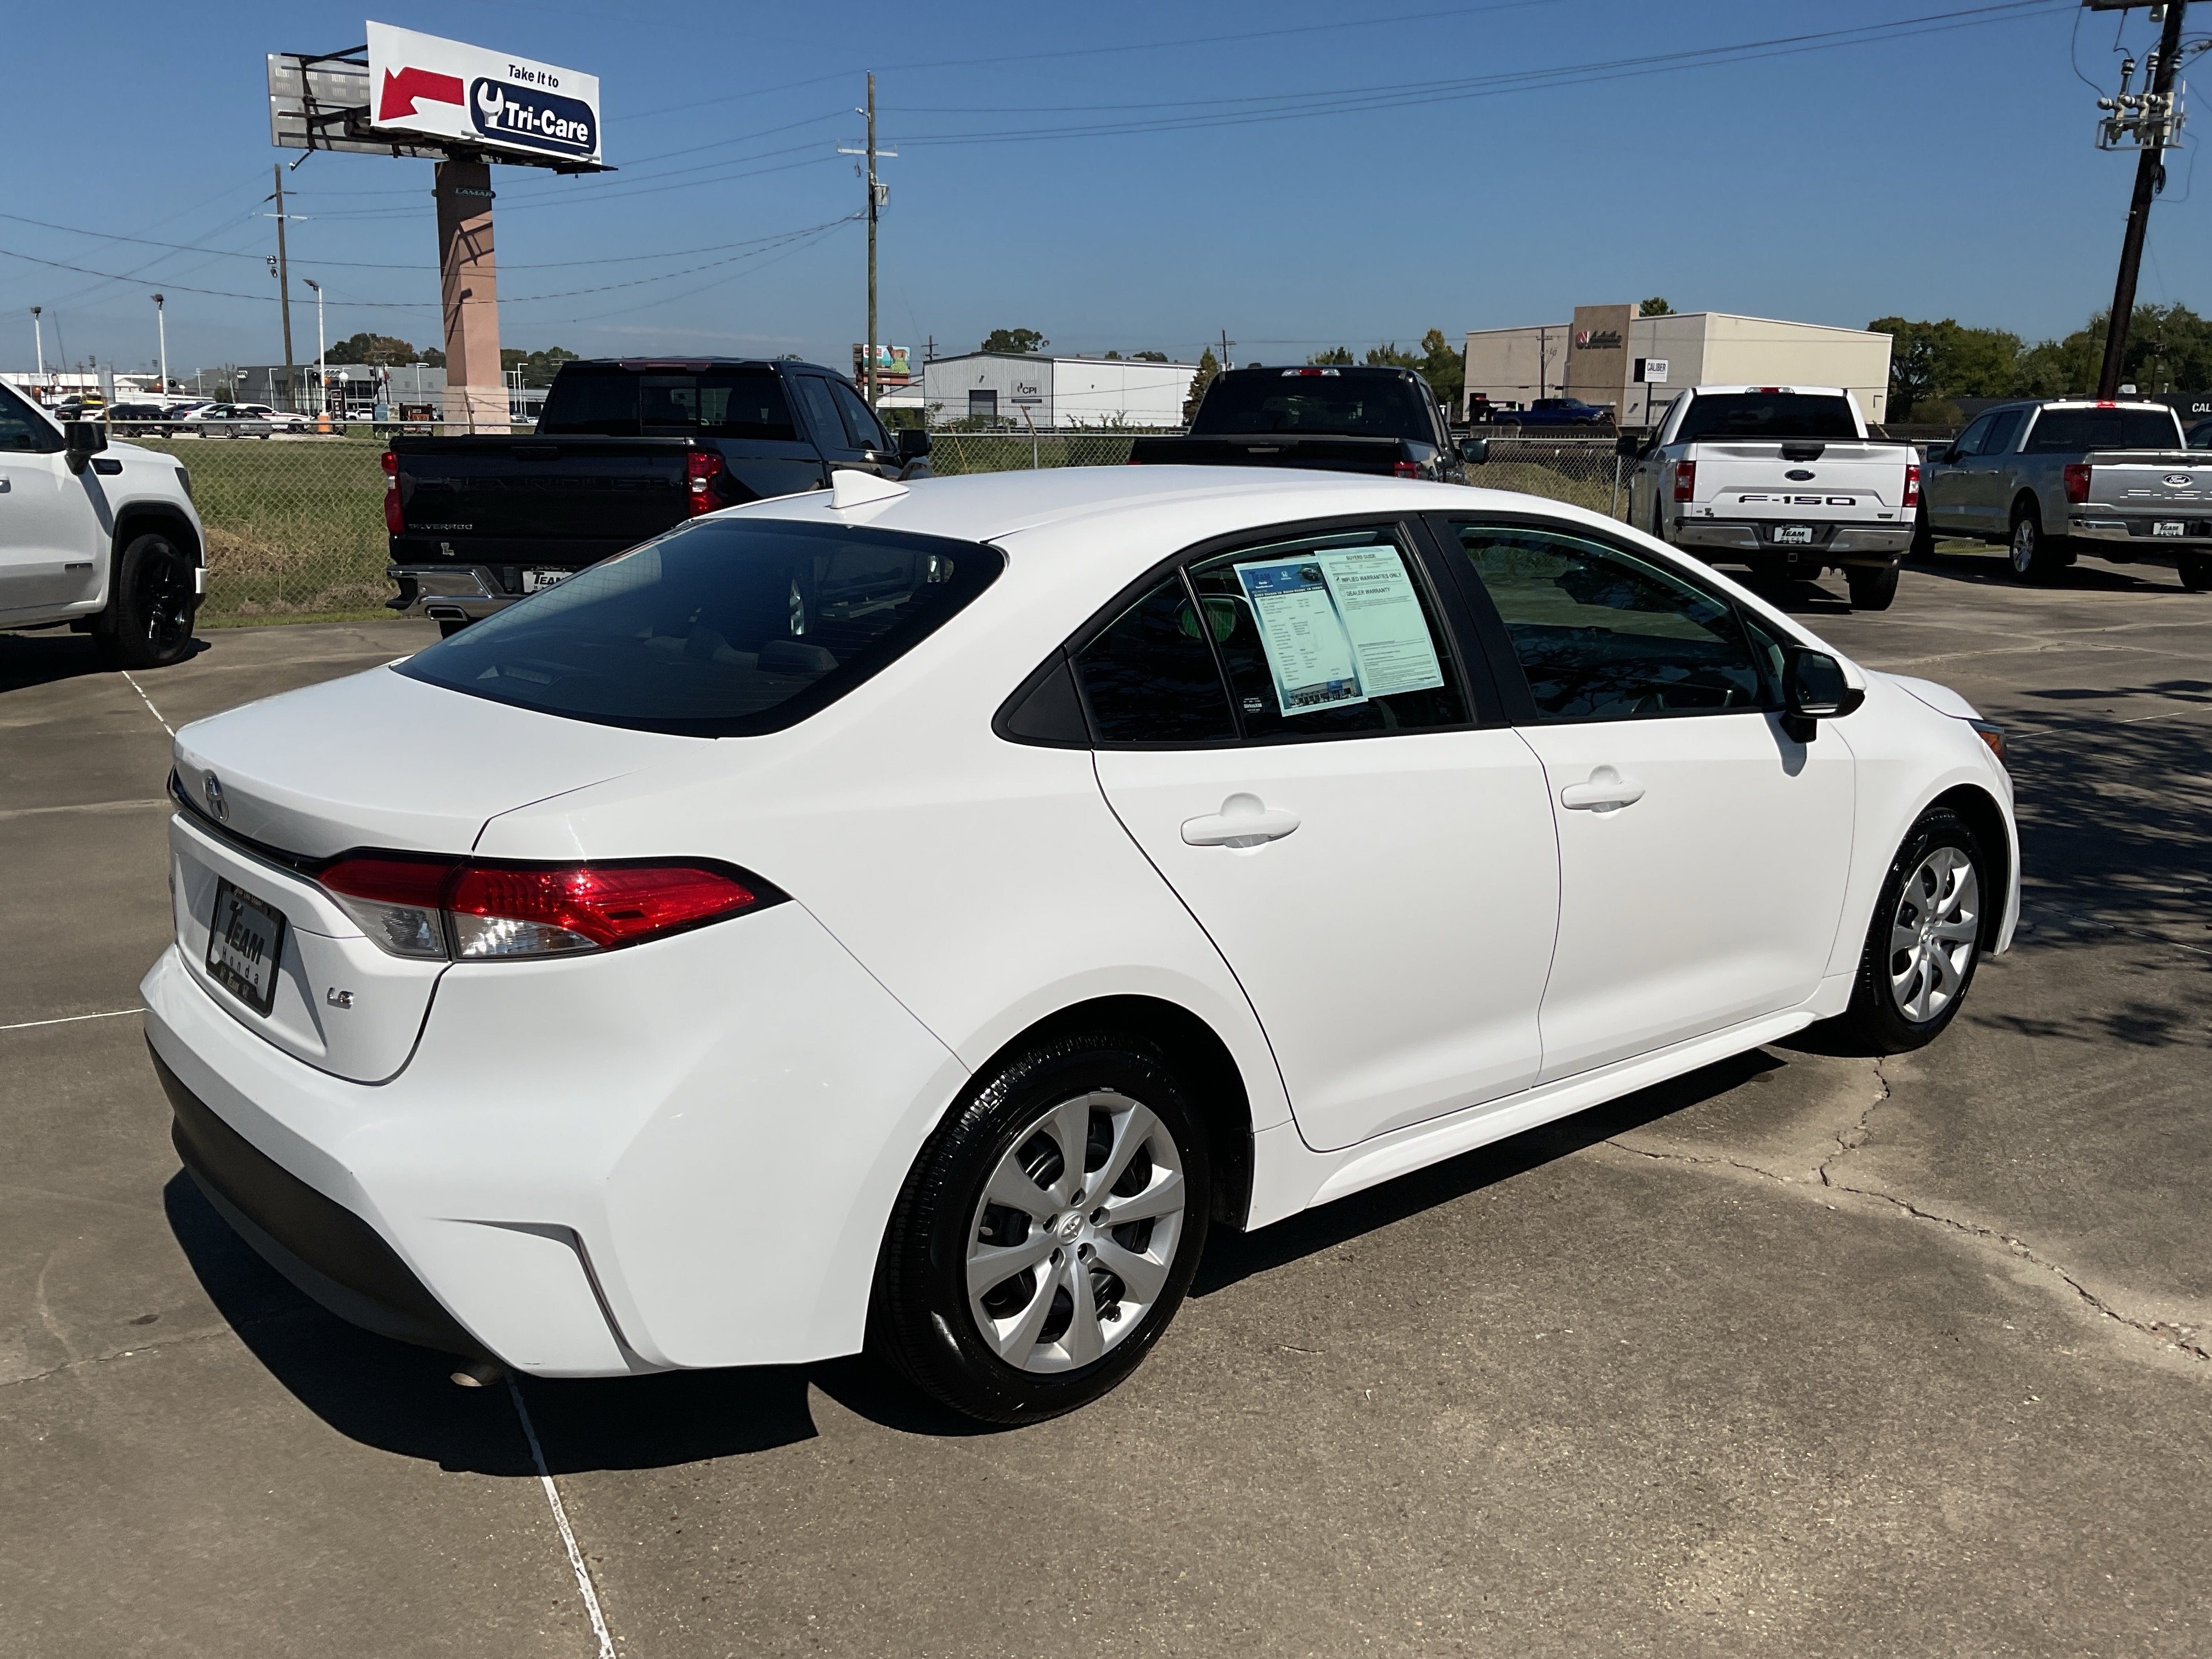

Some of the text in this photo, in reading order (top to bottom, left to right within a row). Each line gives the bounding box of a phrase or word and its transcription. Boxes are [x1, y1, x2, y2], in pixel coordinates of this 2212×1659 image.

[509, 64, 558, 88] Take It to
[505, 101, 588, 142] Tri-Care
[455, 188, 493, 197] LAMAR
[1647, 363, 1666, 371] CALIBER
[2192, 403, 2212, 412] CAL
[2169, 475, 2186, 483] Ford
[1738, 495, 1856, 506] F-150
[1782, 528, 1805, 537] TEAM
[1359, 573, 1389, 582] WARRANTIES
[224, 900, 265, 966] TEAM
[222, 946, 259, 985] Honda
[327, 987, 355, 1006] LE
